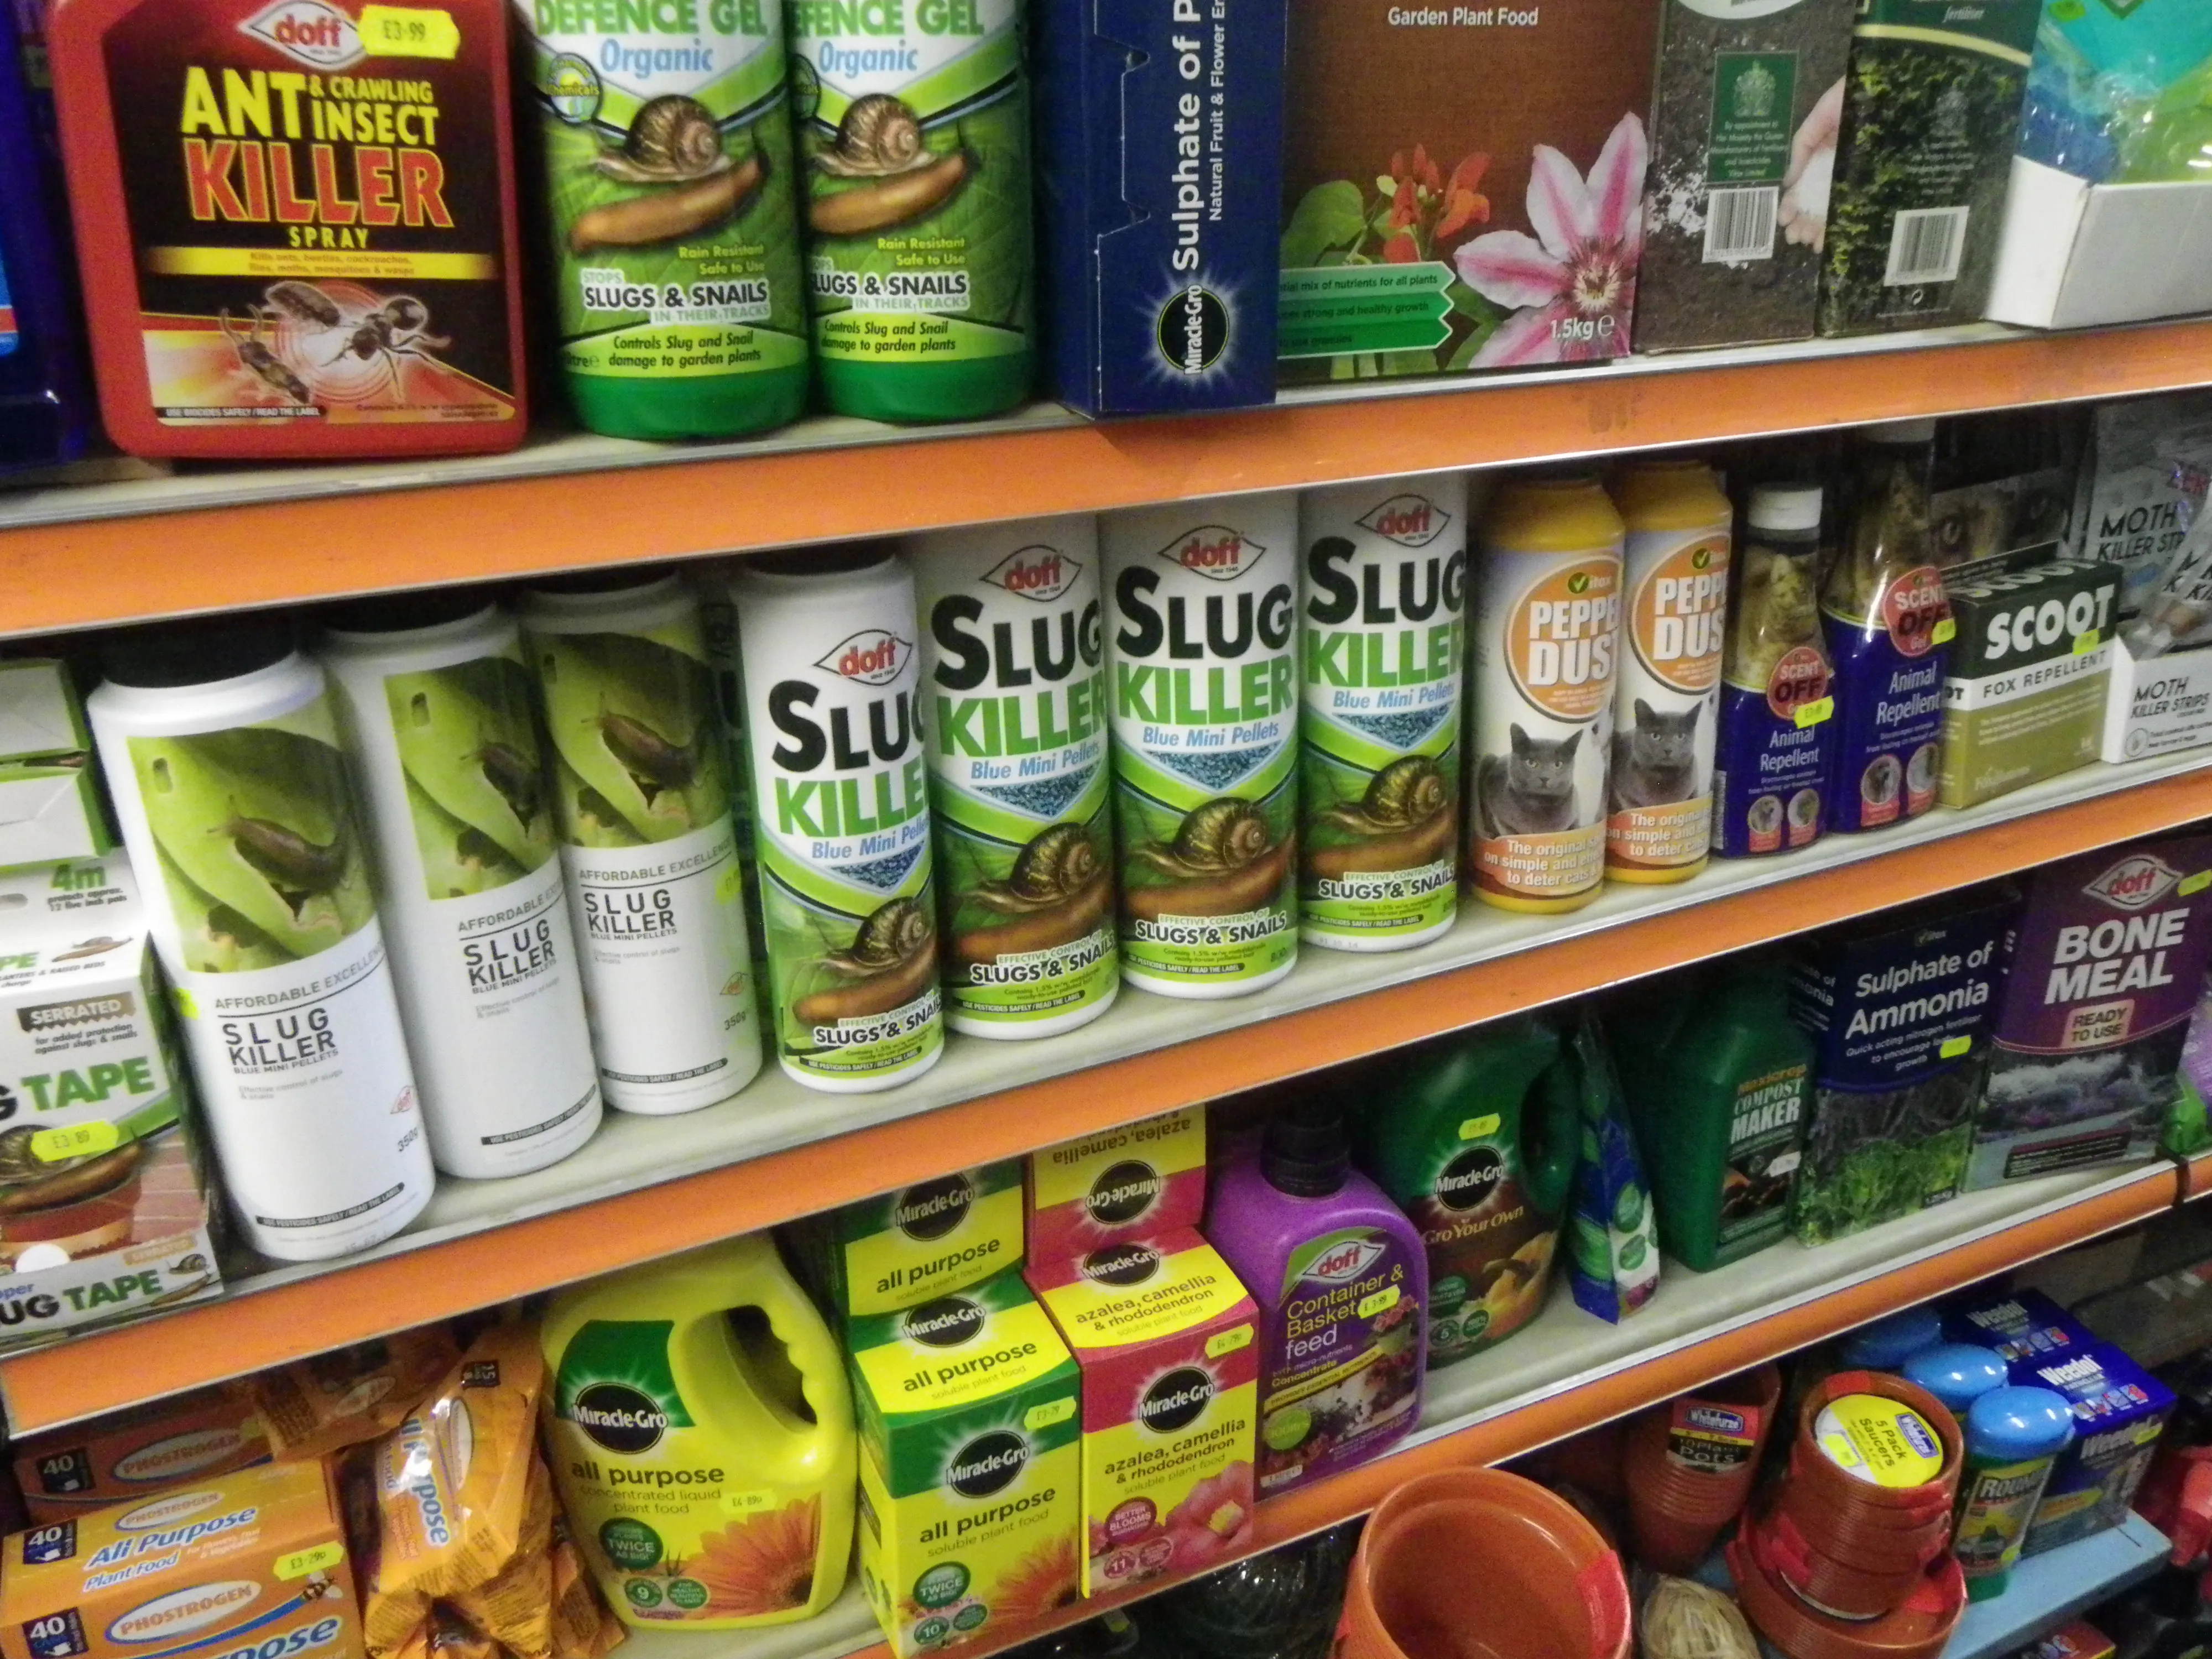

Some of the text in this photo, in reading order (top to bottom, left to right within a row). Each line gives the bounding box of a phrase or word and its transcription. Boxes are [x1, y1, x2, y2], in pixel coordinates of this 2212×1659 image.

[275, 14, 341, 46] doff
[1388, 7, 1538, 27] Garden Plant Food
[601, 39, 712, 78] Organic
[818, 39, 918, 79] Organic
[181, 66, 306, 139] ANT
[310, 74, 434, 103] & CRAWLING
[313, 102, 439, 146] INSECT
[1209, 23, 1225, 221] Natural Fruit & Flower
[1173, 35, 1201, 271] Sulphate of
[182, 138, 455, 227] KILLER
[289, 226, 369, 248] SPRAY
[679, 244, 764, 258] Rain Resistant
[878, 237, 965, 249] Rain Resistant
[896, 254, 965, 266] Safe to Use
[585, 282, 768, 307] SLUGS & SNAILS
[1358, 304, 1392, 316] healthy
[614, 331, 754, 352] Controls Slug and Snail
[825, 321, 948, 336] Controls Slug and Snail
[1551, 317, 1594, 340] 1.5kg
[609, 349, 761, 369] damage to garden plants
[821, 338, 956, 353] damage to garden plants
[1377, 504, 1431, 537] doff
[2100, 500, 2177, 538] MOTH
[1180, 537, 1241, 568] doff
[1004, 556, 1062, 591] doff
[1115, 565, 1294, 660] SLUG
[1529, 593, 1618, 640] PEPPE
[1985, 584, 2115, 660] SCOOT
[838, 640, 897, 677] doff
[1528, 632, 1618, 686] DUS
[1779, 664, 1819, 680] SCENT
[1983, 650, 2107, 699] FOX REPELLENT
[1775, 677, 1822, 703] OFF
[1888, 661, 1937, 695] Animal
[2133, 676, 2190, 703] MOTH
[1333, 681, 1455, 709] Blue Mini Pellets
[1876, 692, 1942, 727] Repellent
[2131, 692, 2210, 719] KILLER STRIPS
[1143, 721, 1280, 748] Blue Mini Pellets
[1769, 728, 1815, 749] Animal
[1760, 748, 1820, 772] Repellent
[1484, 853, 1577, 872] on simple and
[1507, 839, 1586, 858] The original
[1320, 864, 1454, 899] SLUGS & SNAILS
[1507, 869, 1589, 886] to deter cats
[458, 894, 542, 932] AFFORDABLE
[584, 889, 671, 914] SLUG
[588, 910, 676, 933] KILLER
[1136, 914, 1286, 945] SLUGS & SNAILS
[1319, 916, 1350, 926] PESTICIDES
[1404, 916, 1420, 924] LABEL
[2053, 907, 2191, 964] BONE
[463, 919, 550, 966] SLUG
[972, 932, 1114, 983] SLUGS & SNAILS
[468, 940, 555, 987] KILLER
[1855, 940, 1994, 998] Sulphate of
[2044, 951, 2174, 1005] MEAL
[30, 1000, 121, 1025] SERRATED
[1845, 978, 1989, 1040] Ammonia
[2074, 1008, 2128, 1029] READY
[53, 1031, 82, 1042] added
[86, 1023, 133, 1037] protection
[222, 1008, 330, 1045] SLUG
[2072, 1024, 2122, 1042] TO USE
[228, 1030, 336, 1066] KILLER
[1895, 1055, 1928, 1072] growth
[20, 1056, 155, 1112] TAPE
[1730, 1097, 1802, 1144] MAKER
[1425, 1206, 1525, 1245] Gro Your Own
[875, 1237, 1001, 1295] all purpose
[1074, 1272, 1218, 1326] azalea, camellia
[1287, 1263, 1404, 1321] Container &
[1094, 1288, 1215, 1332] & rhododendron
[1286, 1300, 1357, 1339] Basket
[1285, 1324, 1337, 1359] feed
[902, 1342, 1038, 1393] all purpose
[1271, 1359, 1337, 1387] Concentrate
[2037, 1353, 2103, 1386] Weedol
[1105, 1419, 1245, 1475] azalea, camellia
[1859, 1417, 1896, 1468] Saucers
[1875, 1419, 1908, 1460] 5 Pack
[44, 1454, 75, 1474] 40
[571, 1461, 725, 1489] all purpose
[1116, 1438, 1235, 1484] & rhododendron
[613, 1503, 689, 1514] plant food
[920, 1488, 1056, 1543] all purpose
[1109, 1511, 1151, 1531] BLOOMS
[29, 1526, 62, 1546] 40
[608, 1540, 655, 1553] TWICE
[920, 1577, 964, 1596] TWICE
[119, 1584, 252, 1636] PHOSTROGEN
[30, 1616, 65, 1639] 40
[922, 1624, 940, 1637] 10
